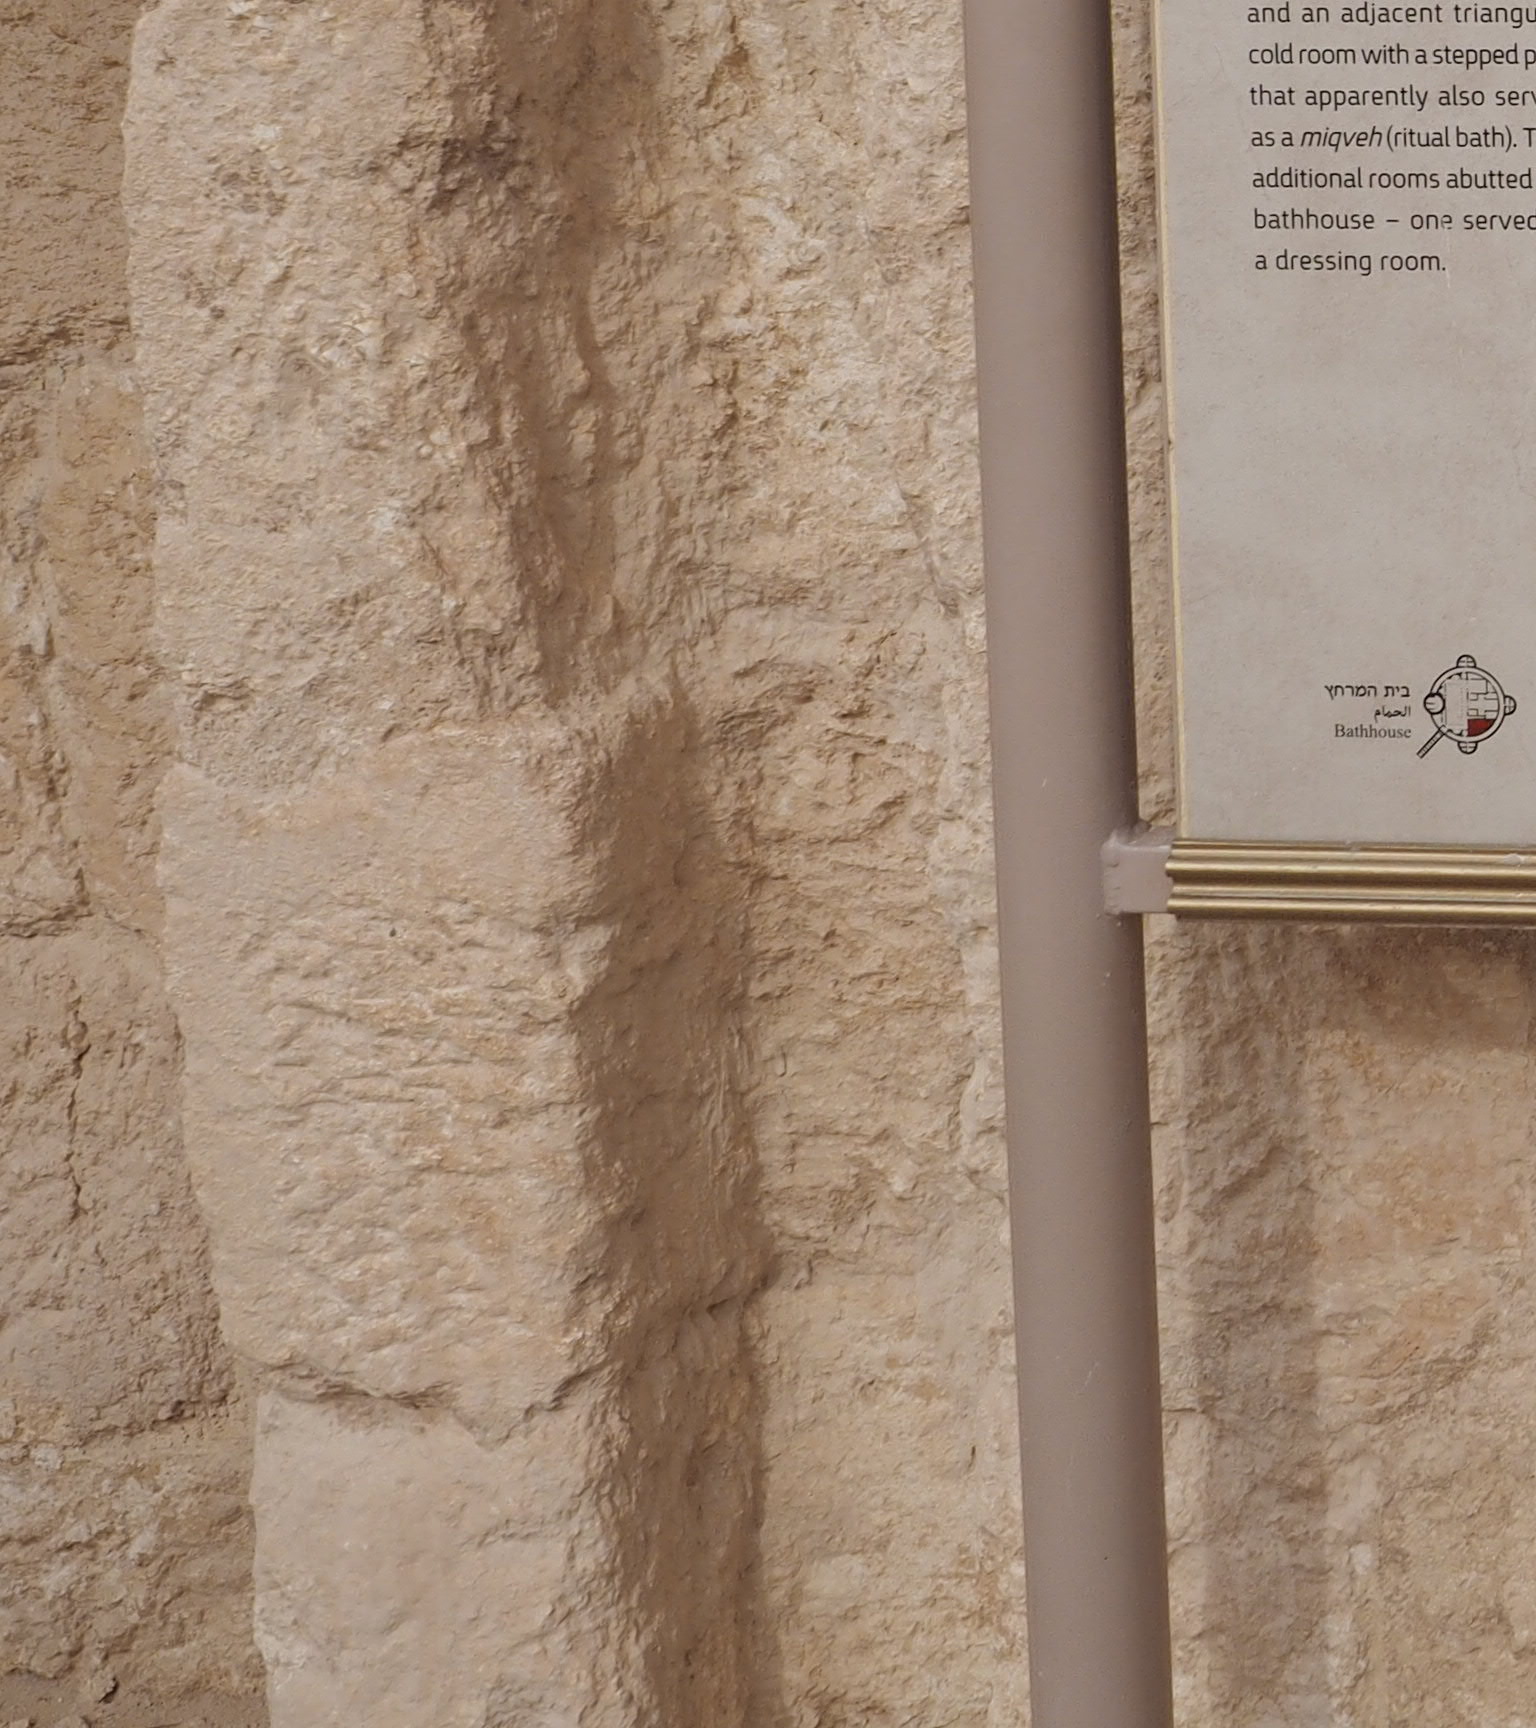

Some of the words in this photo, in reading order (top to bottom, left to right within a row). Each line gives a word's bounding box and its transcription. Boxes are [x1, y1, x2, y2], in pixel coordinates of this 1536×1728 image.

[1247, 1, 1291, 23] and
[1302, 7, 1329, 23] an
[1341, 1, 1443, 26] adjacent
[1249, 42, 1295, 64] cold
[1299, 49, 1356, 64] room
[1361, 43, 1409, 64] with
[1415, 49, 1428, 64] a
[1432, 42, 1520, 70] stepped
[1250, 84, 1295, 106] that
[1305, 84, 1428, 111] apparently
[1438, 84, 1485, 106] also
[1251, 131, 1275, 147] as
[1281, 132, 1294, 147] a
[1300, 126, 1382, 153] miqveh
[1387, 125, 1451, 152] (ritual
[1456, 125, 1517, 153] bath).
[1253, 166, 1363, 188] additional
[1369, 173, 1440, 188] rooms
[1446, 167, 1533, 189] abutted
[1254, 208, 1375, 229] bathhouse
[1411, 214, 1452, 230] one
[1255, 255, 1268, 270] a
[1276, 248, 1371, 276] dressing
[1381, 255, 1446, 271] room.
[1324, 685, 1377, 700] המרחץ
[1383, 686, 1410, 698] בית
[1374, 705, 1411, 723] الحمام
[1335, 724, 1411, 738] Bathhouse
